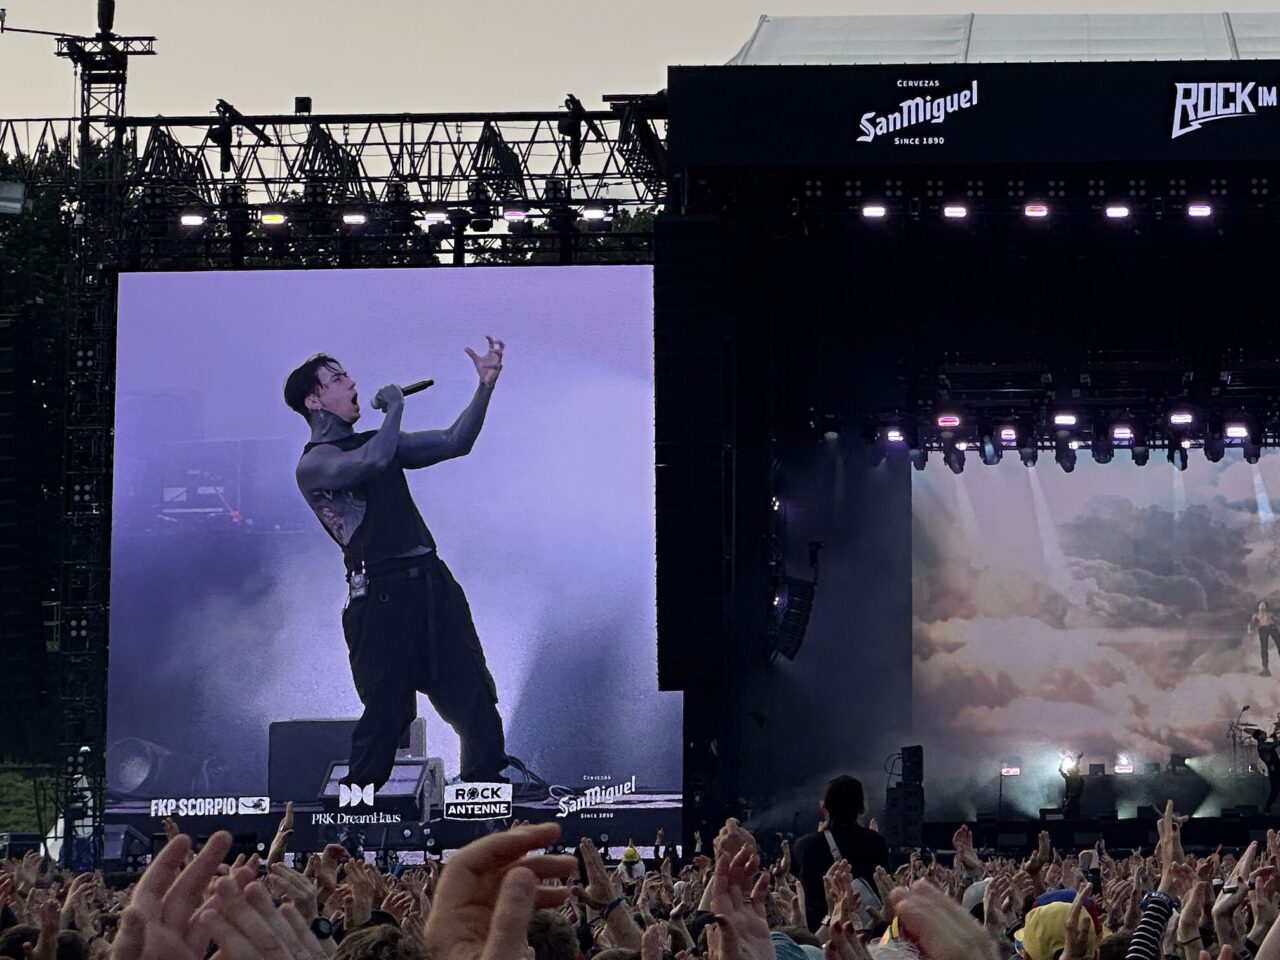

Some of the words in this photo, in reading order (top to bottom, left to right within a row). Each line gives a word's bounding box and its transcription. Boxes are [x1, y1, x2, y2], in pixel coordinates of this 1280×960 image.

[896, 79, 940, 87] CERVEZAS
[1171, 81, 1258, 139] ROCK
[1257, 85, 1278, 107] IM
[922, 136, 945, 145] 1890
[455, 787, 502, 801] ROCK
[150, 798, 177, 817] FKP
[178, 797, 237, 817] SCORPIO
[447, 803, 509, 815] ANTENNE
[311, 812, 335, 825] PRK
